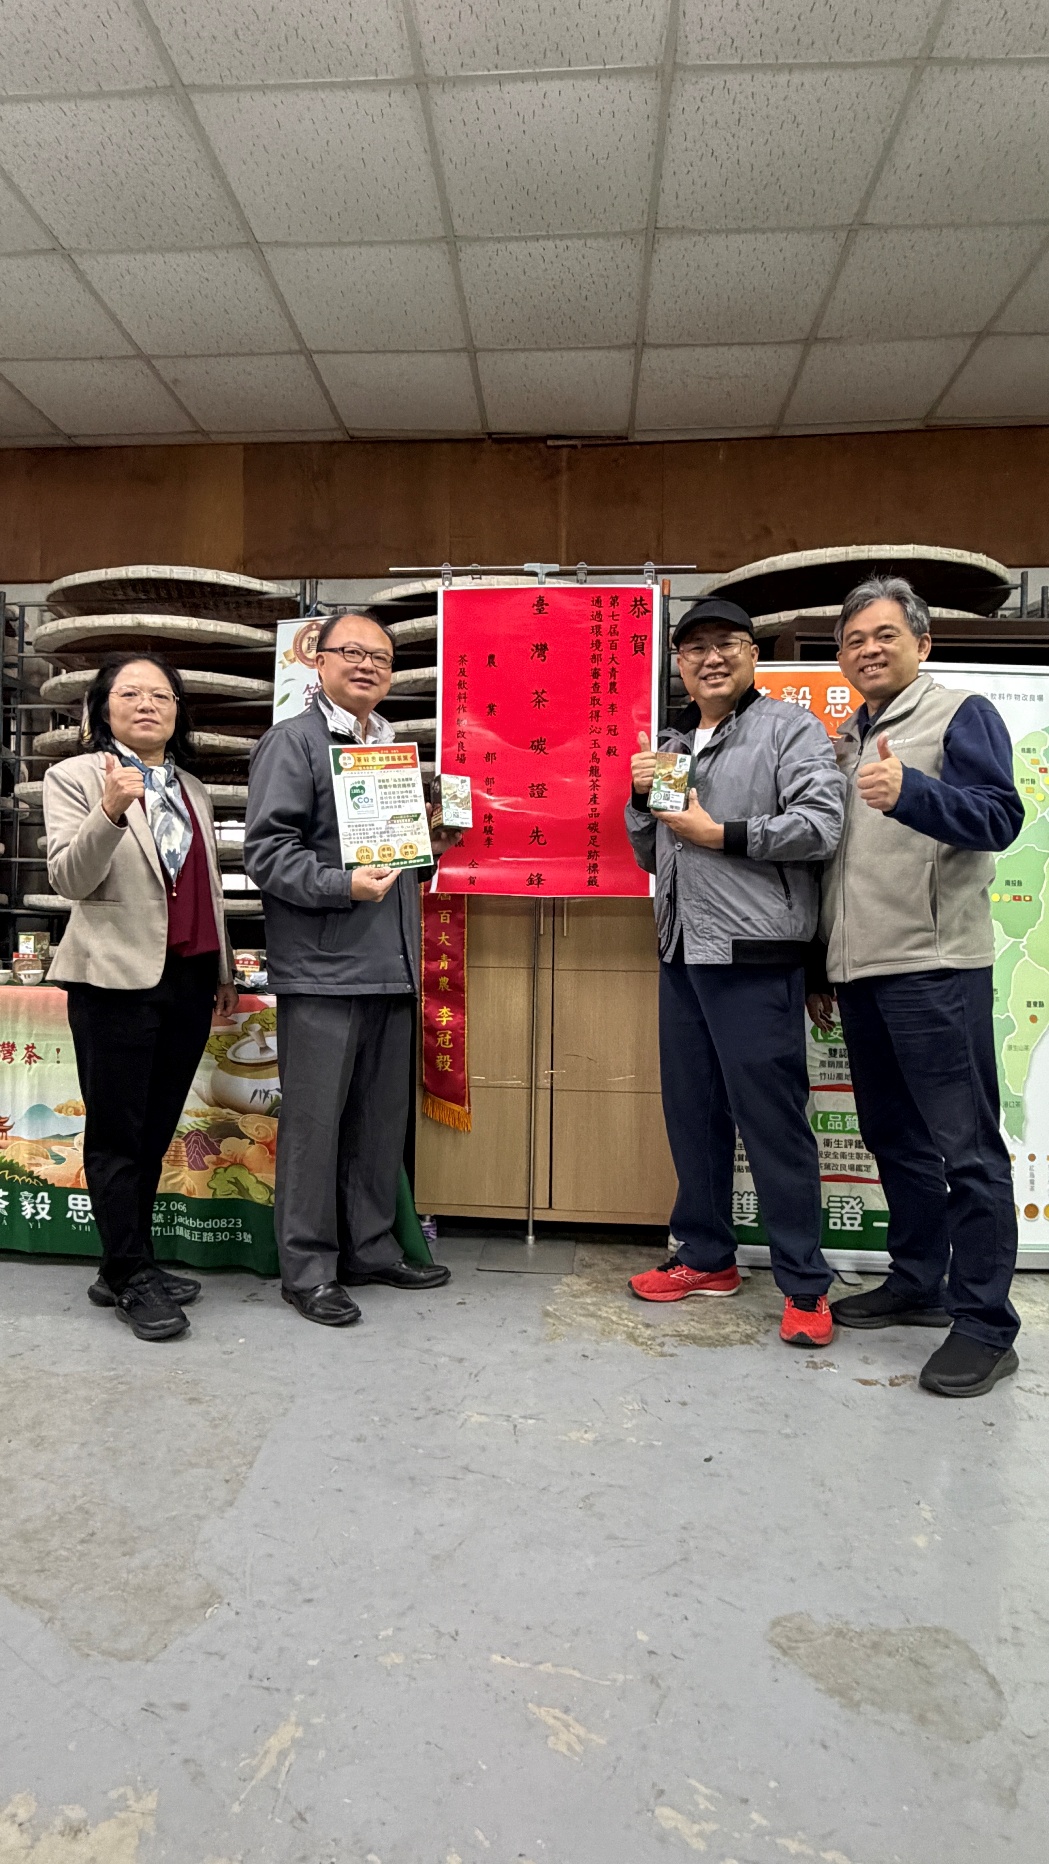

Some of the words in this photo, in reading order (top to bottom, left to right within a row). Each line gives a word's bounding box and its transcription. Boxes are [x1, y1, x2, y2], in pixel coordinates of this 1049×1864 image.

[607, 595, 620, 694] 第七屆百大青農
[628, 595, 651, 657] 恭賀
[526, 595, 549, 888] 臺灣茶碳證先鋒
[606, 702, 619, 757] 李冠毅
[436, 1006, 454, 1072] 李冠毅
